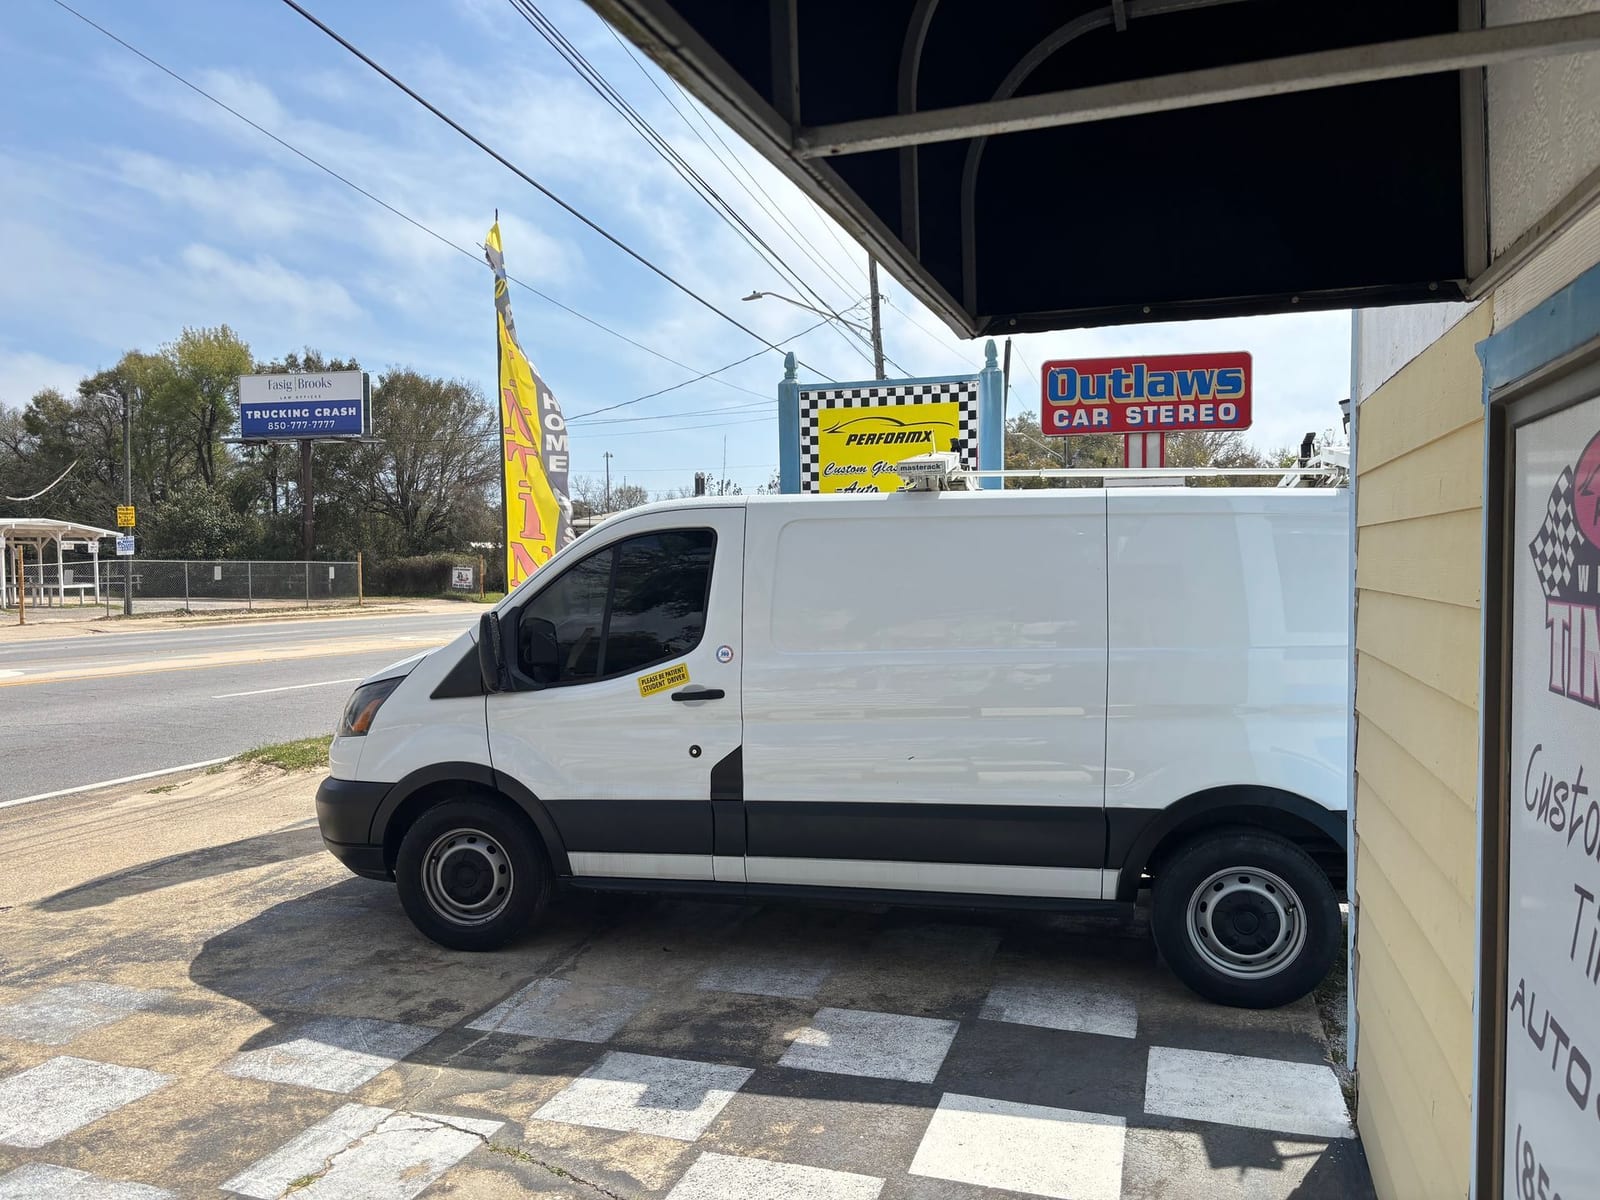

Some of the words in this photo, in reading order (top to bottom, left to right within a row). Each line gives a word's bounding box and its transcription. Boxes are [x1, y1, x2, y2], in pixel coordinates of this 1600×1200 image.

[298, 377, 332, 389] Brooks
[1048, 363, 1246, 406] Outlaws
[246, 408, 309, 419] TRUCKING
[315, 407, 356, 417] CRASH
[1053, 407, 1110, 428] CAR
[1126, 402, 1238, 425] STEREO
[267, 420, 335, 430] 850-777-7777
[543, 392, 569, 473] HOME
[846, 430, 933, 446] PERFORMX
[824, 462, 868, 478] Custom
[900, 463, 940, 471] masterack
[641, 675, 658, 685] PLEASE
[665, 667, 684, 677] PATIENT
[643, 680, 666, 692] STUDENT
[667, 673, 685, 684] DRIVER
[1525, 744, 1600, 863] Custo
[1570, 883, 1600, 985] Ti
